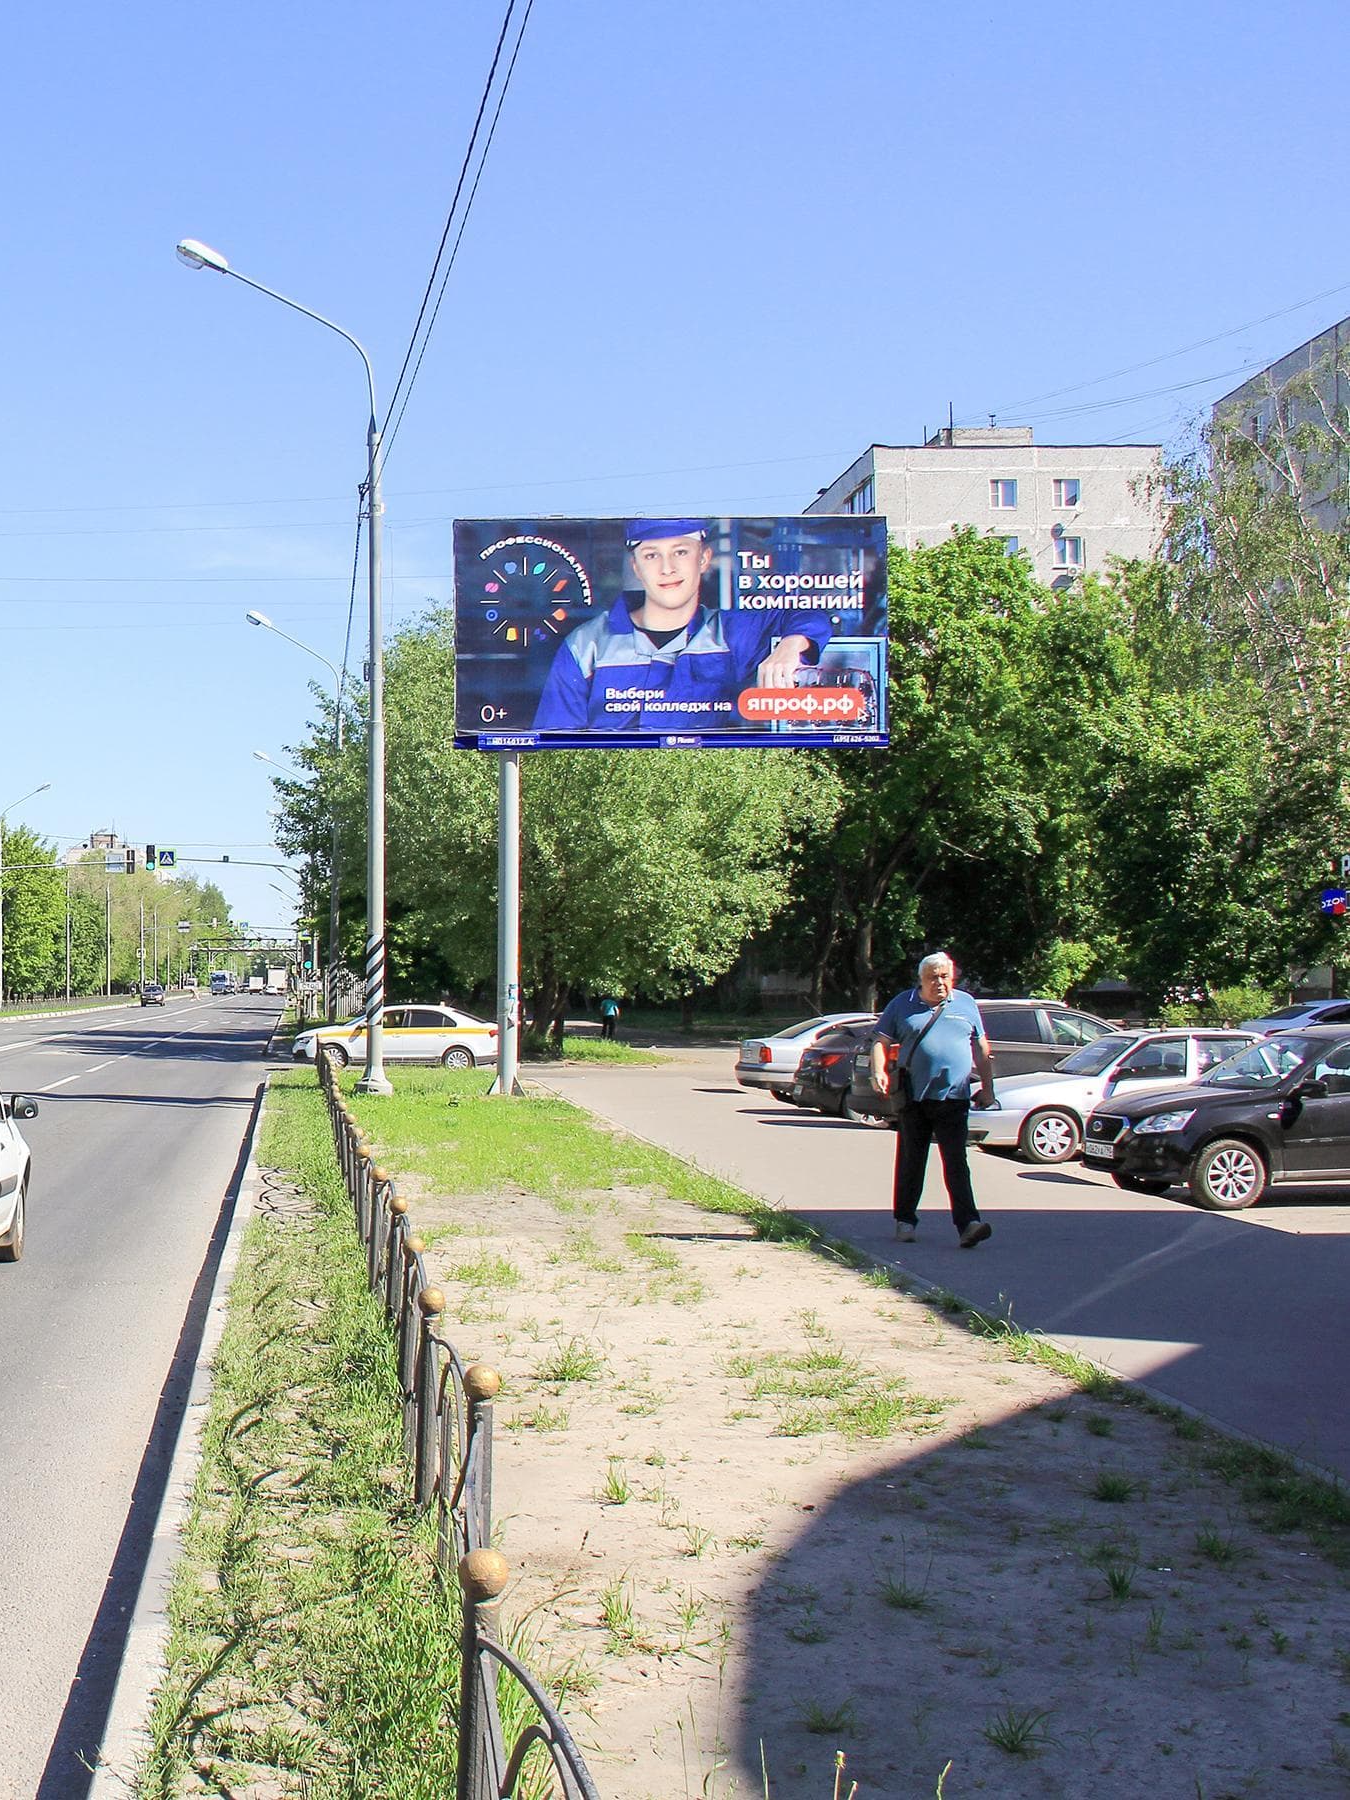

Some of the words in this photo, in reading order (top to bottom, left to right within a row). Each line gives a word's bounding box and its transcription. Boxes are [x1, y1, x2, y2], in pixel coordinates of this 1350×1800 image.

[737, 551, 771, 569] Ты
[479, 535, 592, 606] ПРОФЕССИОНАЛИТЕТ
[738, 575, 751, 589] в
[757, 570, 864, 593] хорошей
[738, 592, 864, 610] компании!
[605, 687, 665, 701] Выбери
[480, 704, 508, 723] 0+
[605, 699, 641, 712] свой
[644, 701, 712, 714] колледж
[714, 701, 732, 712] на
[746, 694, 855, 715] япроф.рф
